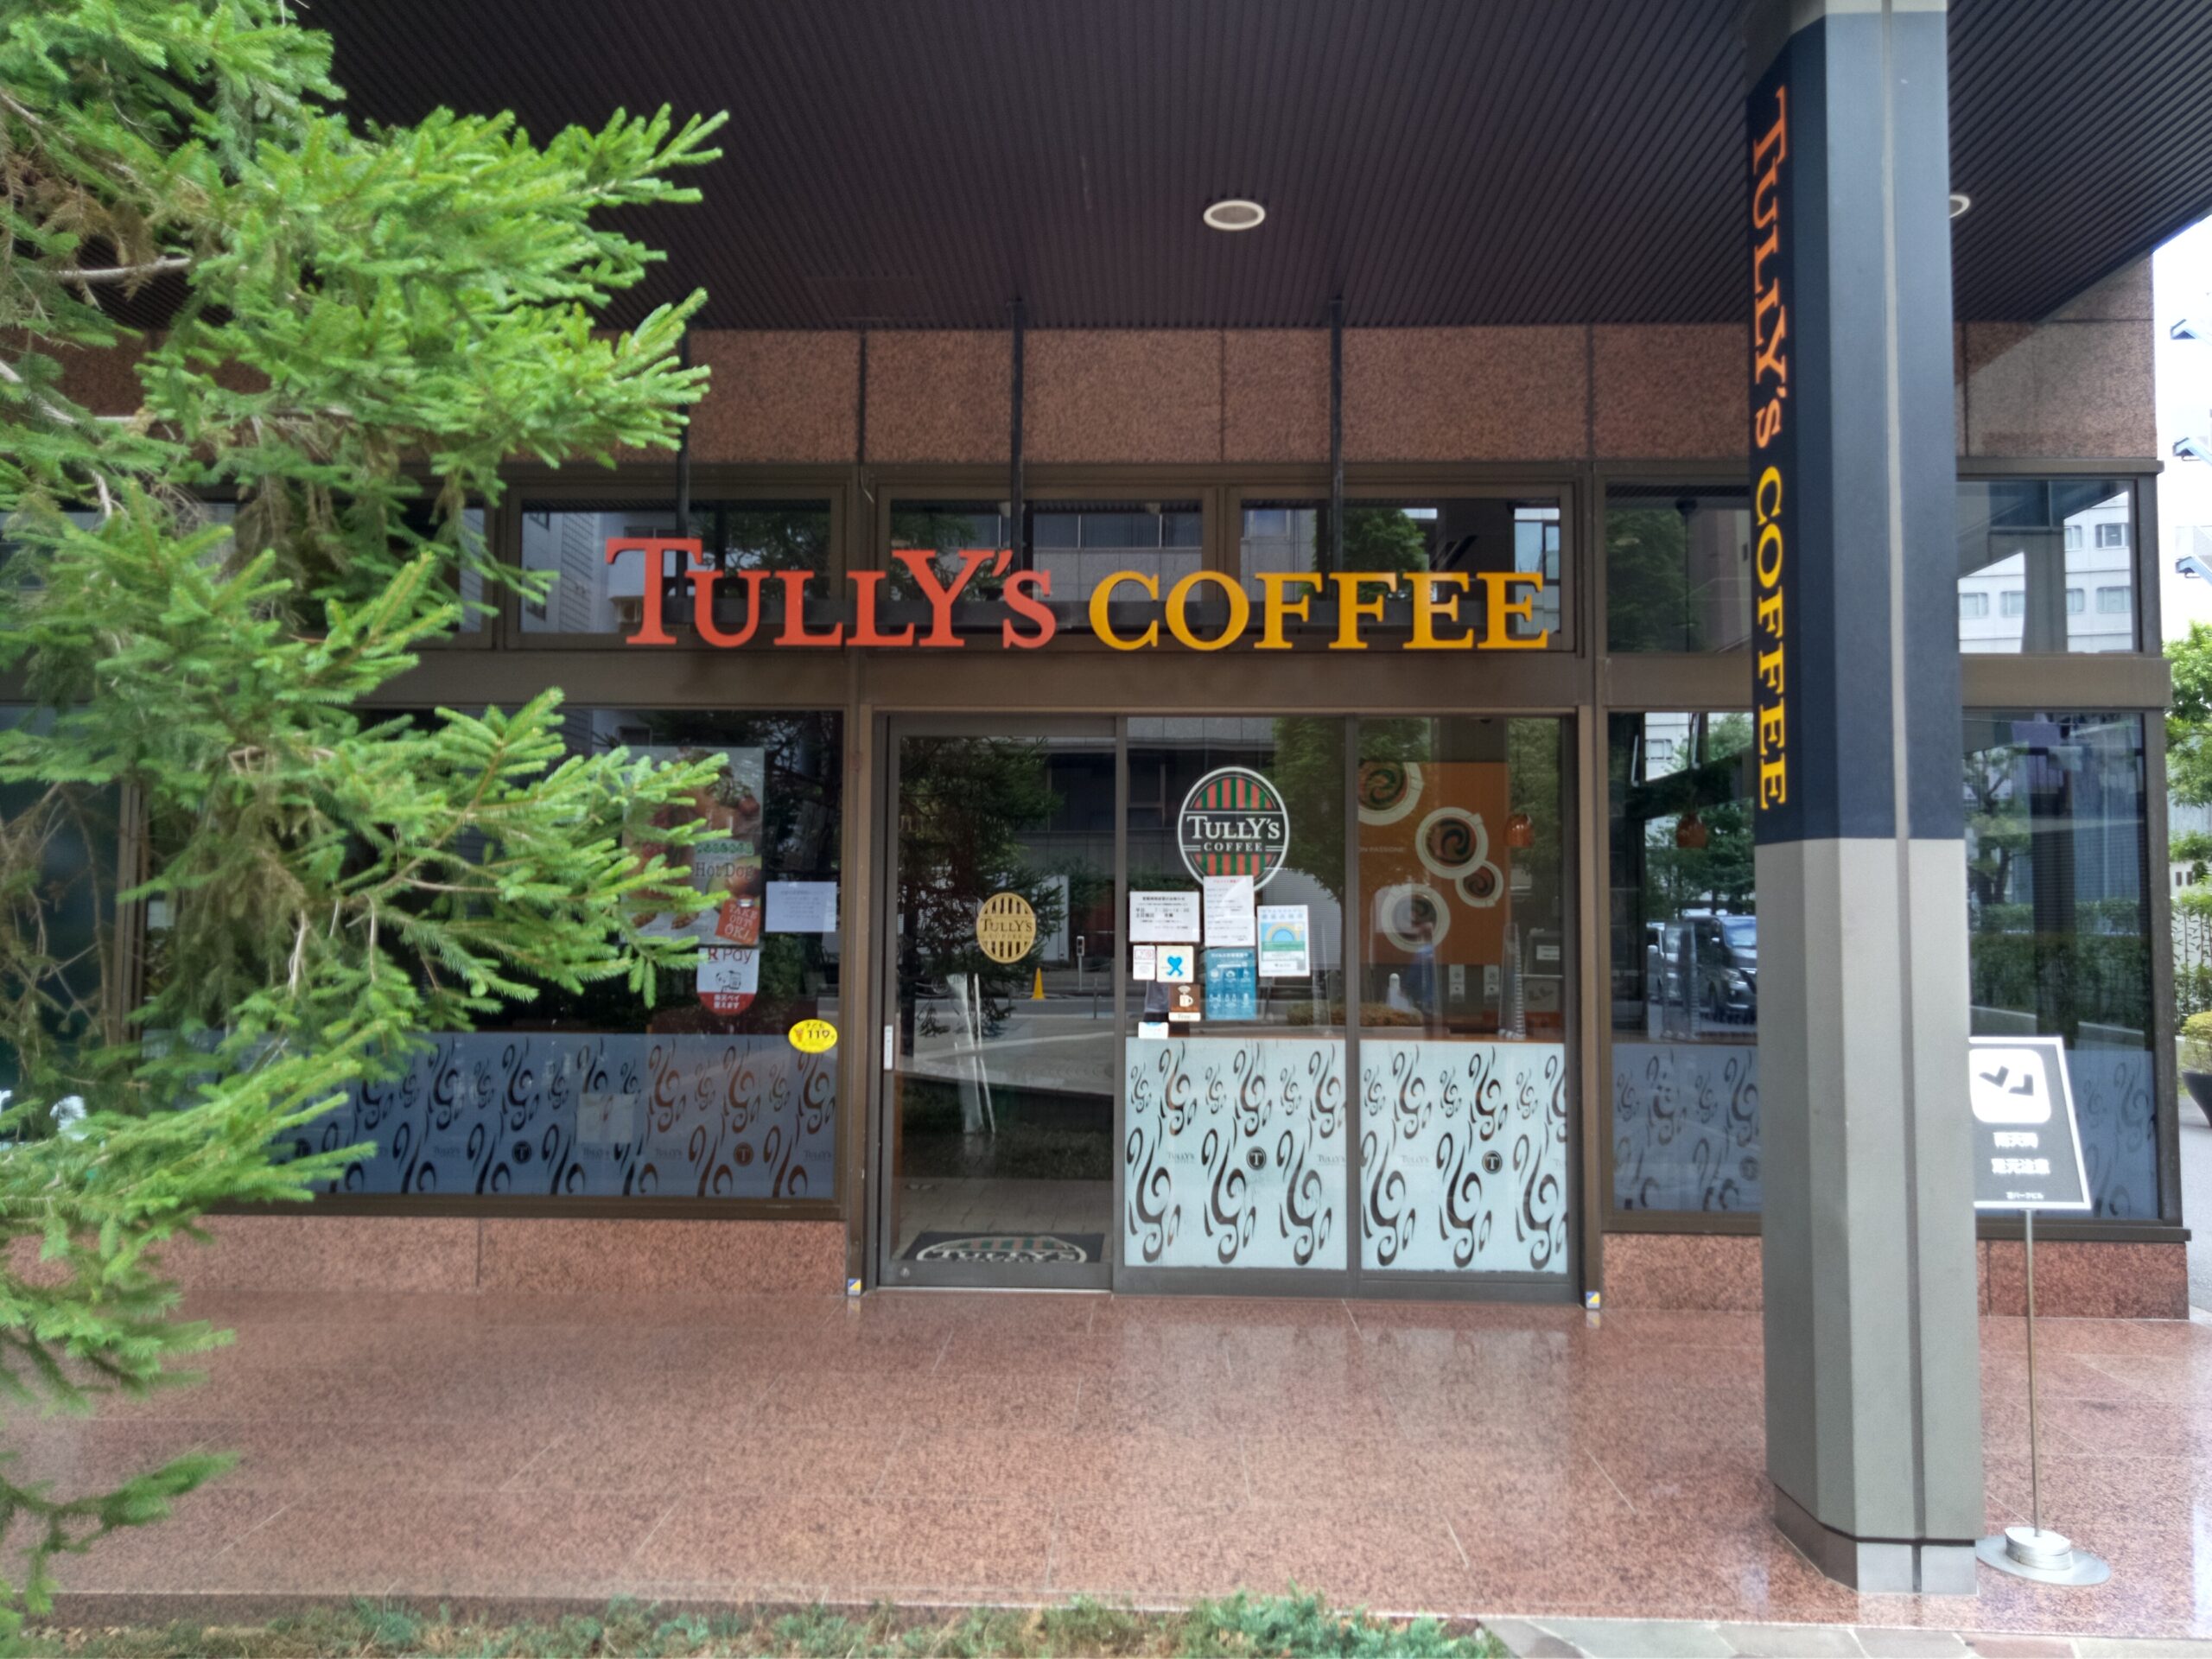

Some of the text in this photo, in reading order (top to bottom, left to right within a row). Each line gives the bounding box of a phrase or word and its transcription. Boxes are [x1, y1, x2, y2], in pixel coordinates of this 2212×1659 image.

[1752, 84, 1789, 811] TULLY'S COFFEE
[606, 537, 1549, 652] TULLY'S COFFEE
[1186, 816, 1281, 840] TULLY'S
[1204, 842, 1263, 852] COFFEE
[695, 861, 754, 880] Hot Dog
[729, 904, 759, 919] TAKE
[980, 918, 1033, 932] TULLY'S
[722, 948, 753, 964] Pay
[1251, 1153, 1262, 1165] T
[1487, 1156, 1497, 1169] T
